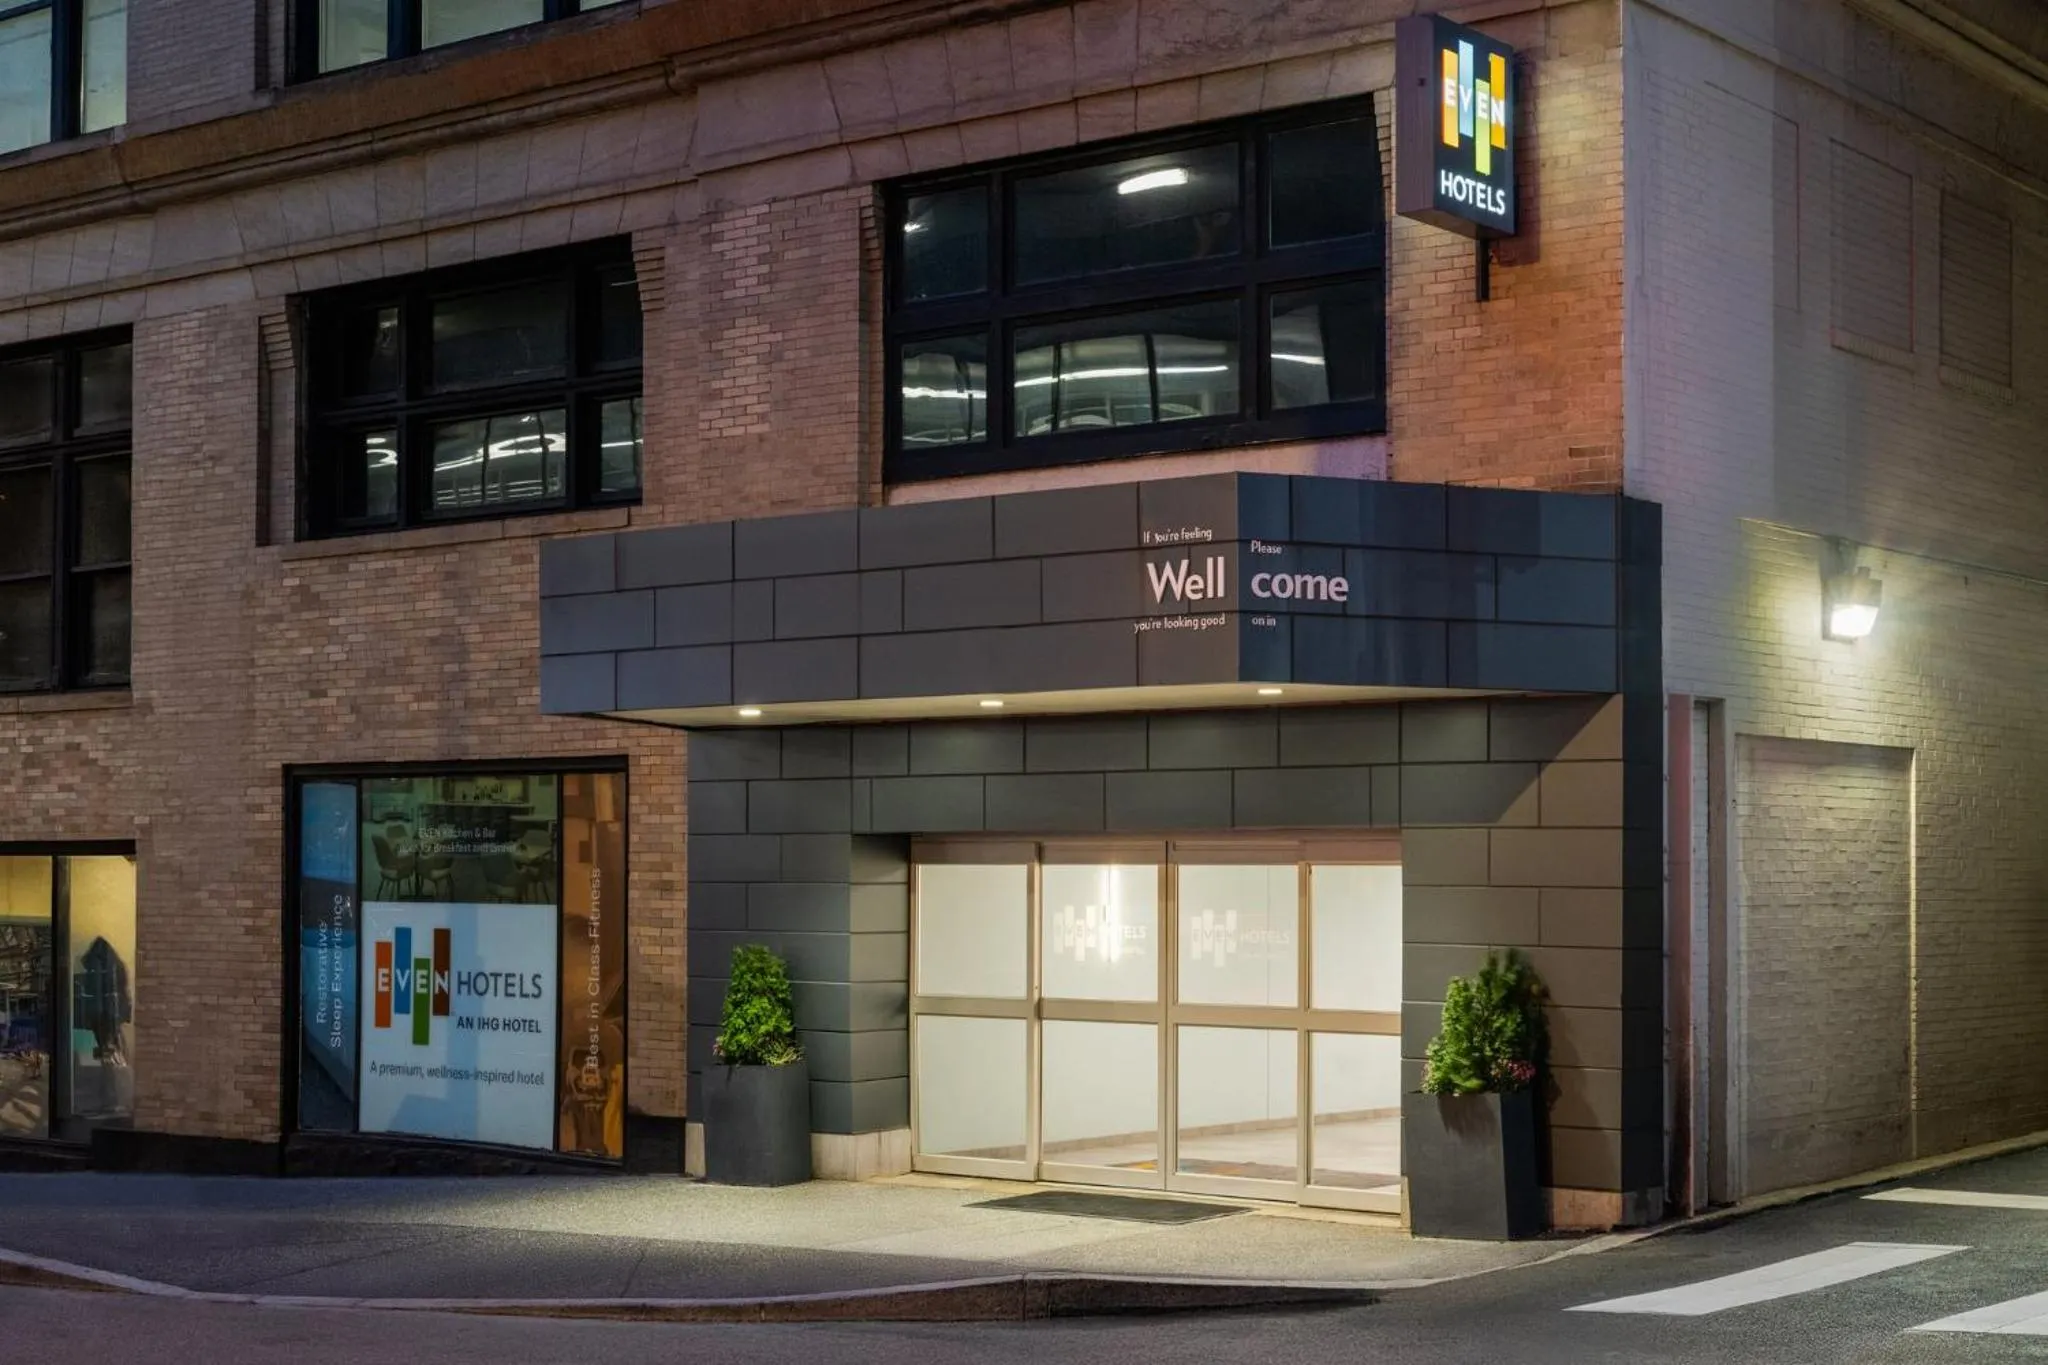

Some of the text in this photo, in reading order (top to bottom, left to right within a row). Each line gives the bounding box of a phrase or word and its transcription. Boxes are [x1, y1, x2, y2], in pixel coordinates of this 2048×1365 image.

[1444, 78, 1506, 125] EVEN
[1441, 169, 1506, 215] HOTELS
[1143, 527, 1212, 545] If you're feeling
[1250, 540, 1283, 554] Please
[1147, 556, 1225, 604] Well
[1250, 572, 1349, 602] come
[1134, 614, 1226, 634] you're looking good
[1251, 616, 1276, 627] on in
[315, 920, 328, 1024] Restorative
[330, 894, 344, 1048] Sleep Experience
[377, 967, 542, 999] EVEN HOTELS
[586, 867, 600, 1068] Best in Class Fitness
[456, 1016, 542, 1034] AN IHG HOTEL
[369, 1060, 545, 1086] A premium, wellness-inspired hotel
